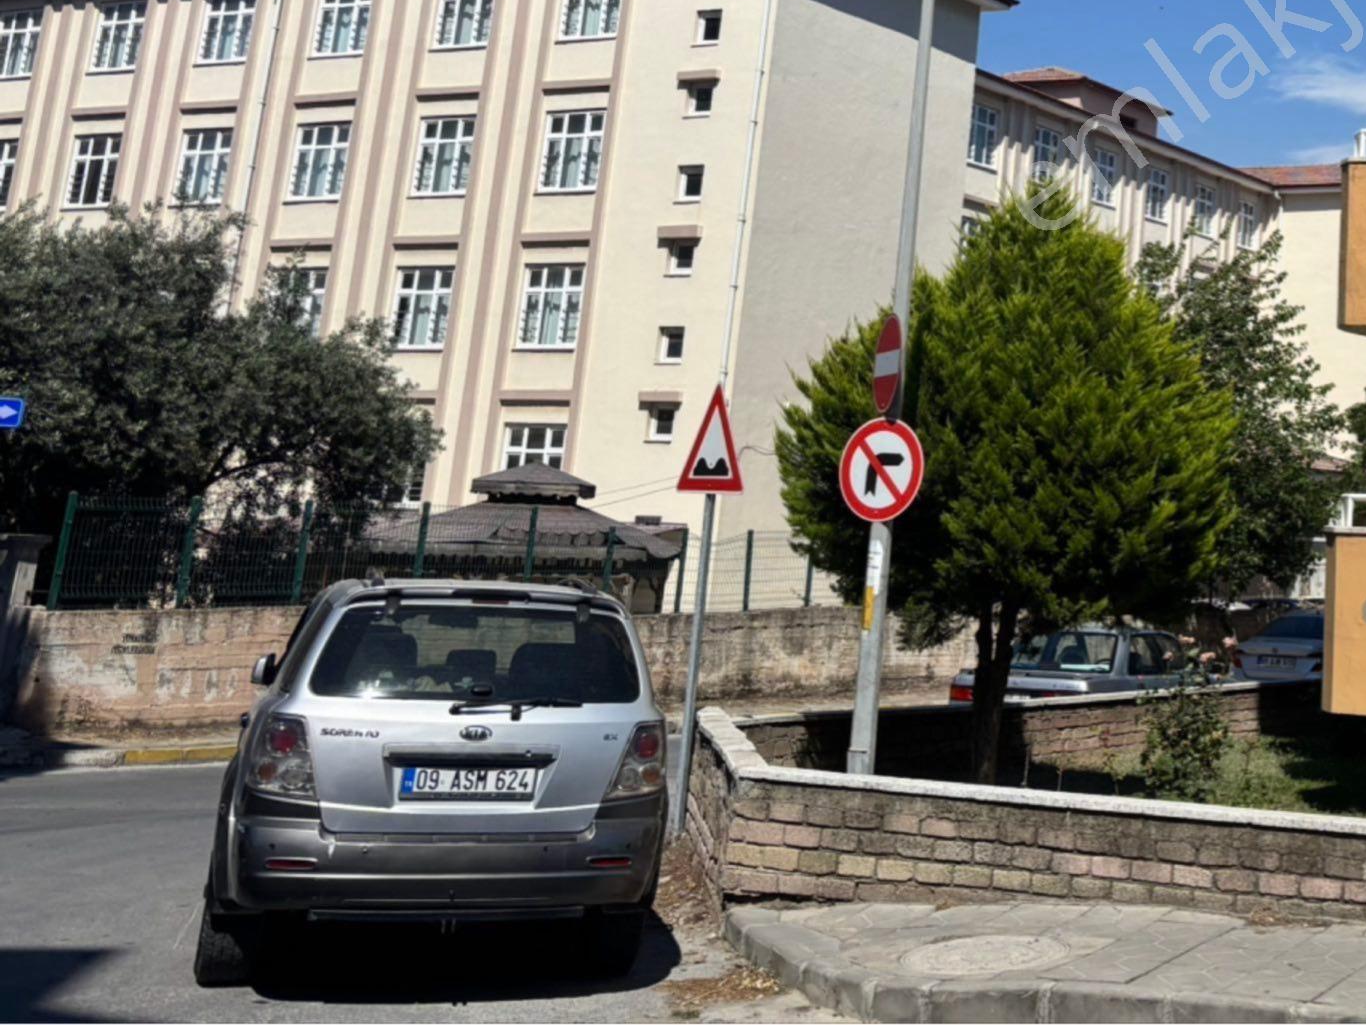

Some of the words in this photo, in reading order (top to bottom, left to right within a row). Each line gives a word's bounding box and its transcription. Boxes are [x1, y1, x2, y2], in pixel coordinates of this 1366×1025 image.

[462, 727, 489, 740] KIA
[416, 769, 440, 791] 09
[450, 769, 488, 791] ASM
[495, 769, 529, 791] 624
